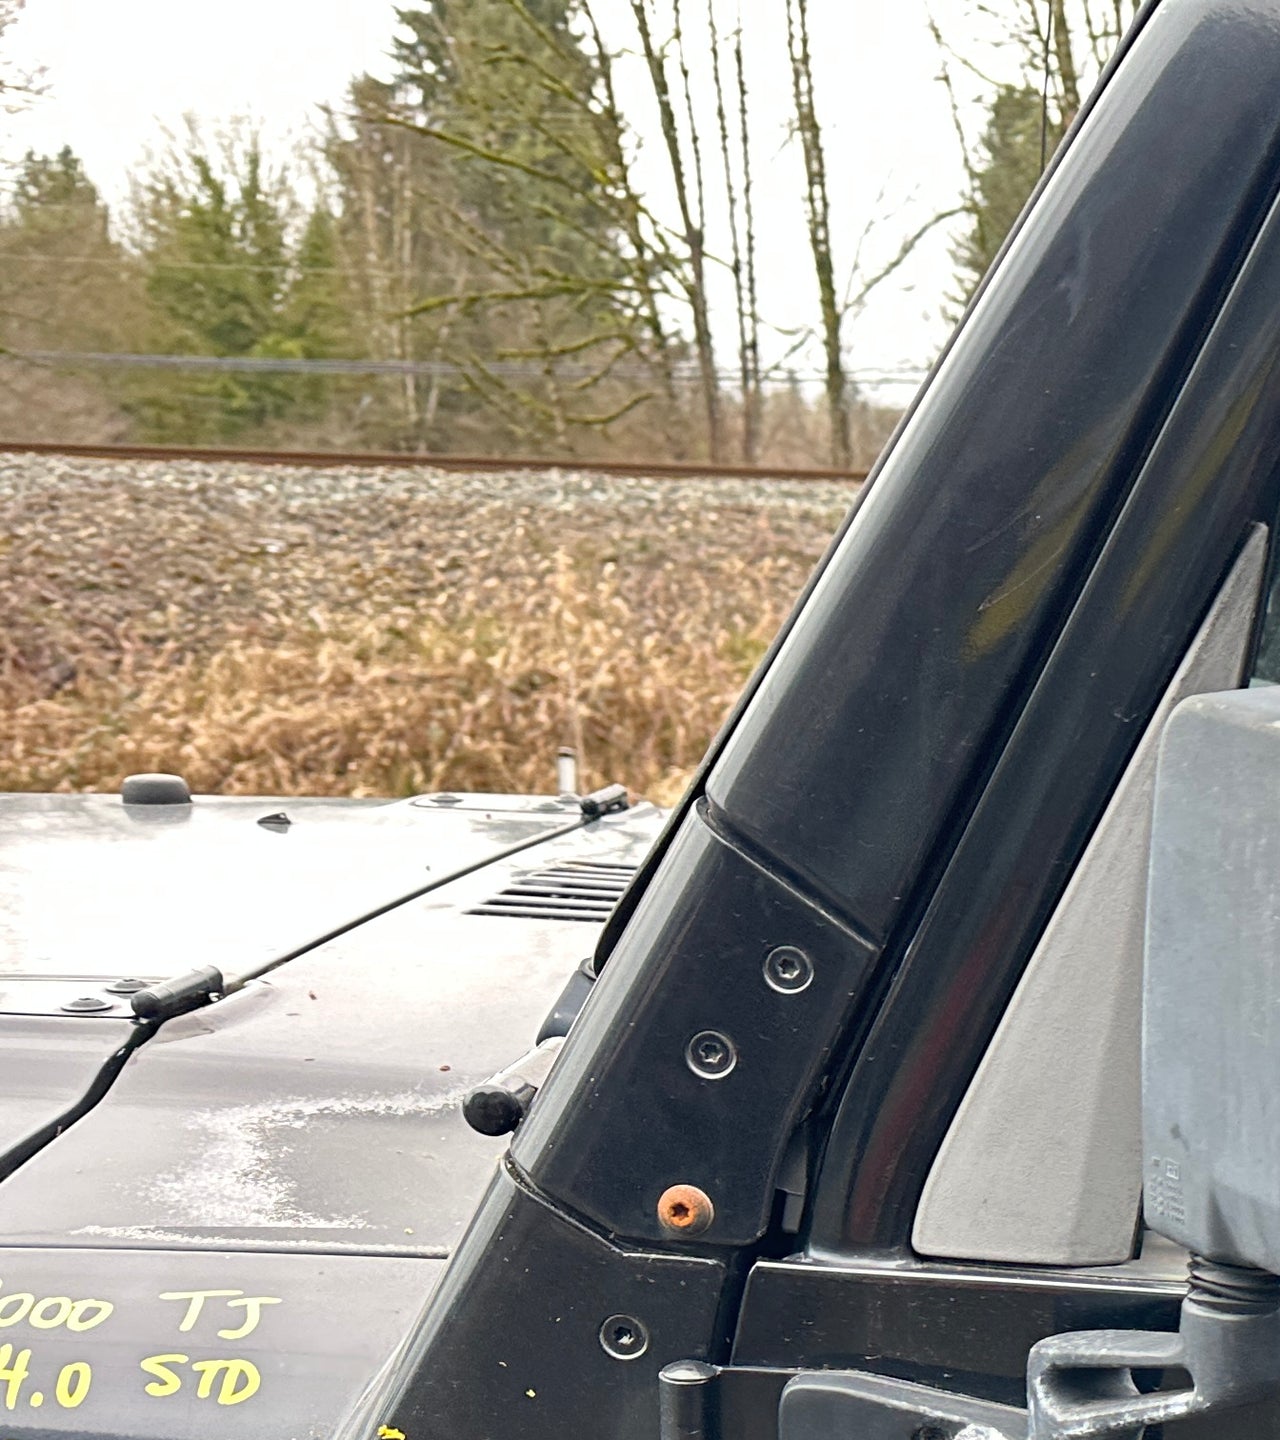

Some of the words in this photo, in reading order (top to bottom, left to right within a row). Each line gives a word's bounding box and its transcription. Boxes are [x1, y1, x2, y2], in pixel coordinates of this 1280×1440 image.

[0, 1279, 114, 1332] 000
[159, 1288, 283, 1341] TJ
[0, 1343, 92, 1409] 4.0
[140, 1353, 261, 1405] STD
